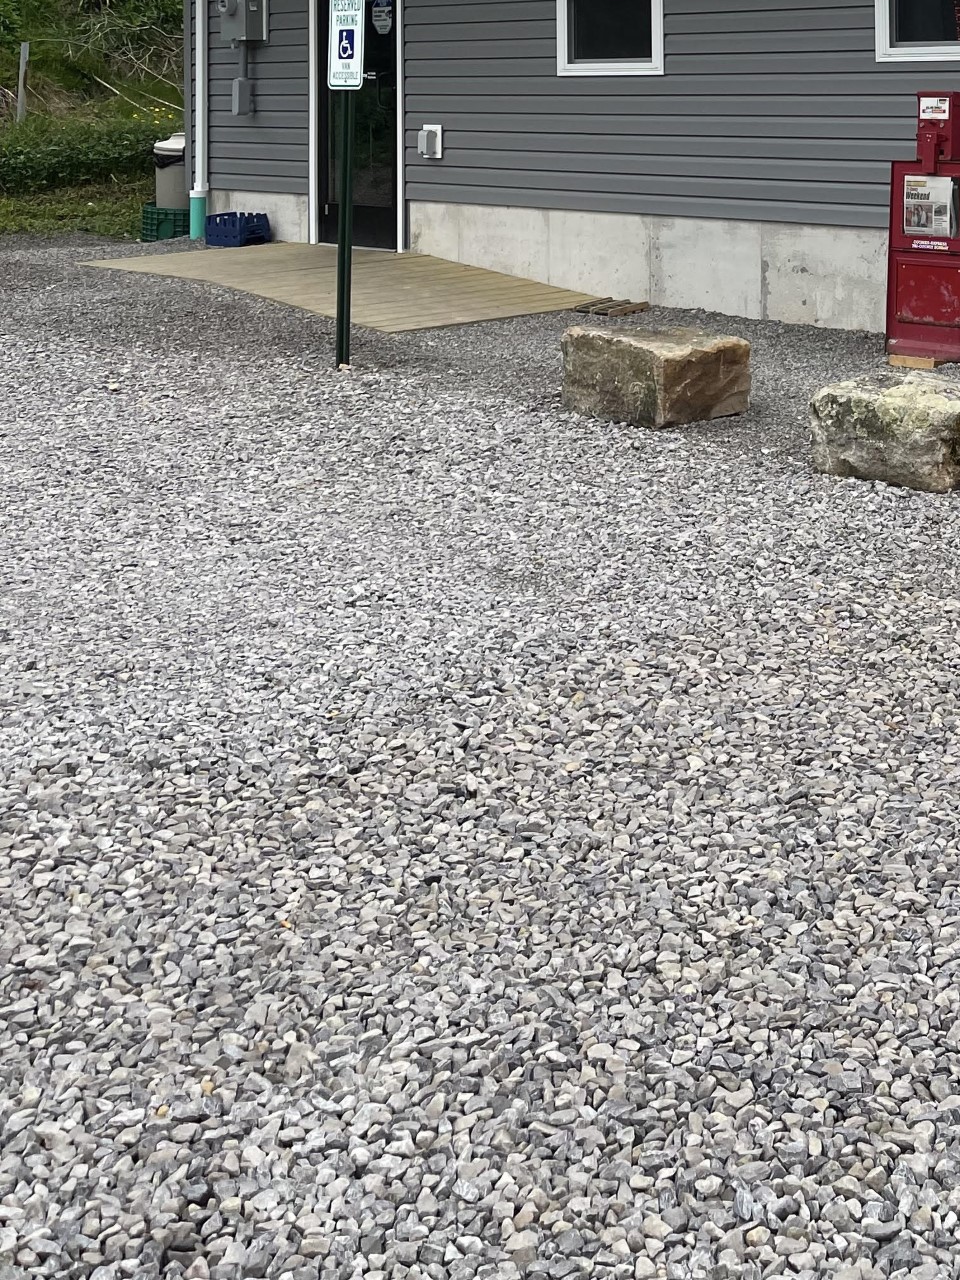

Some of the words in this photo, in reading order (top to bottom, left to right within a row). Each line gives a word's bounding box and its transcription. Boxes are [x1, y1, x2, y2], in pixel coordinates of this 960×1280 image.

[336, 14, 358, 27] PARKING
[341, 62, 350, 70] VAN
[332, 71, 359, 80] ACCESSIBLE
[905, 191, 931, 201] Weekend
